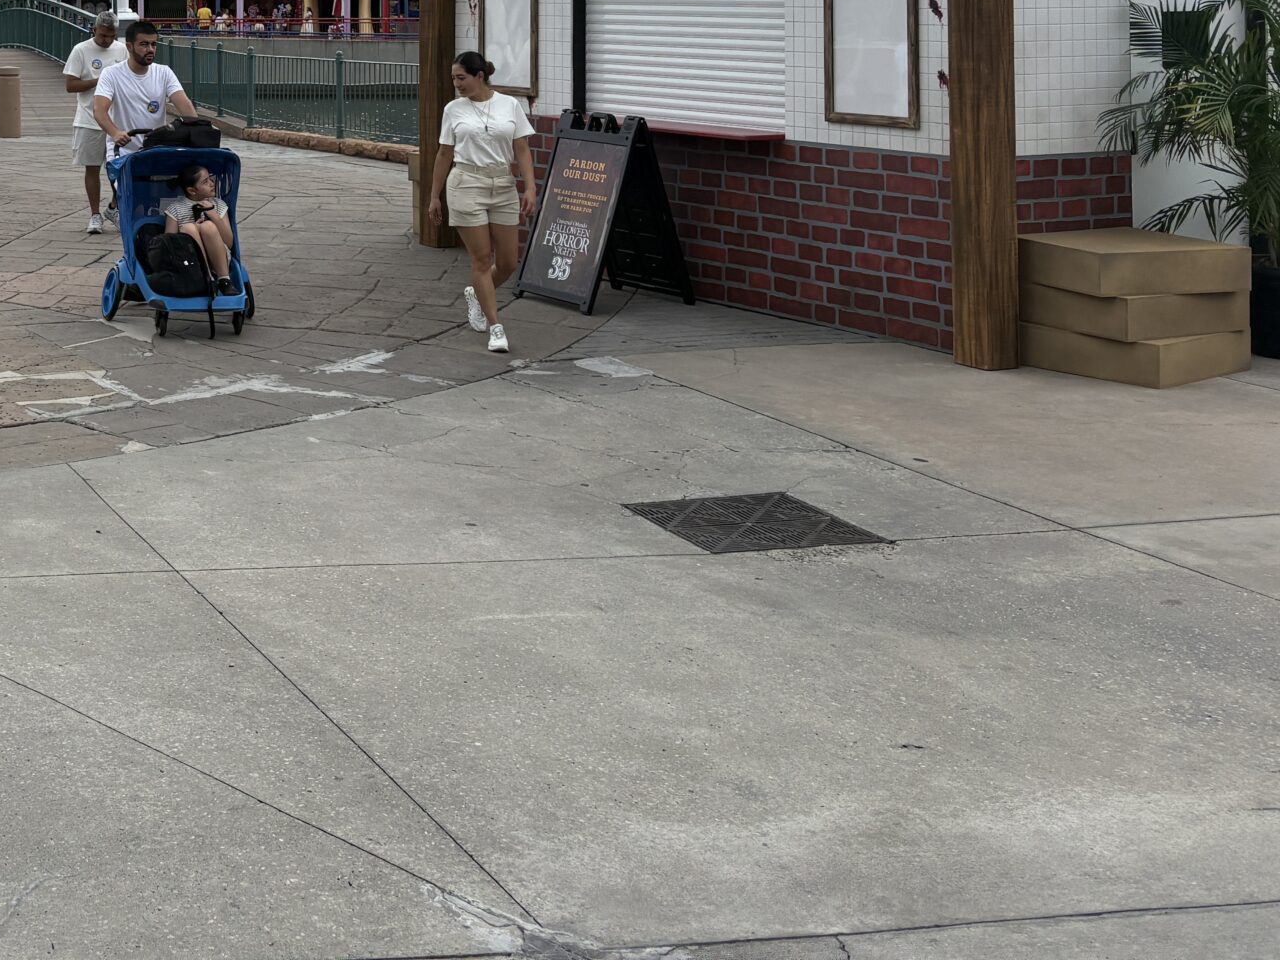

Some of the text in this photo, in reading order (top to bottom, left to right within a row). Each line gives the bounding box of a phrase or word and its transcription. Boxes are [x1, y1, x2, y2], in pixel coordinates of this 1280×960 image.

[569, 158, 606, 171] PARDON
[562, 168, 607, 183] OUR DUST
[550, 223, 591, 237] HALLOWEEN
[543, 230, 590, 256] HORROR
[552, 245, 578, 258] NIGHTS
[548, 256, 573, 281] 35
